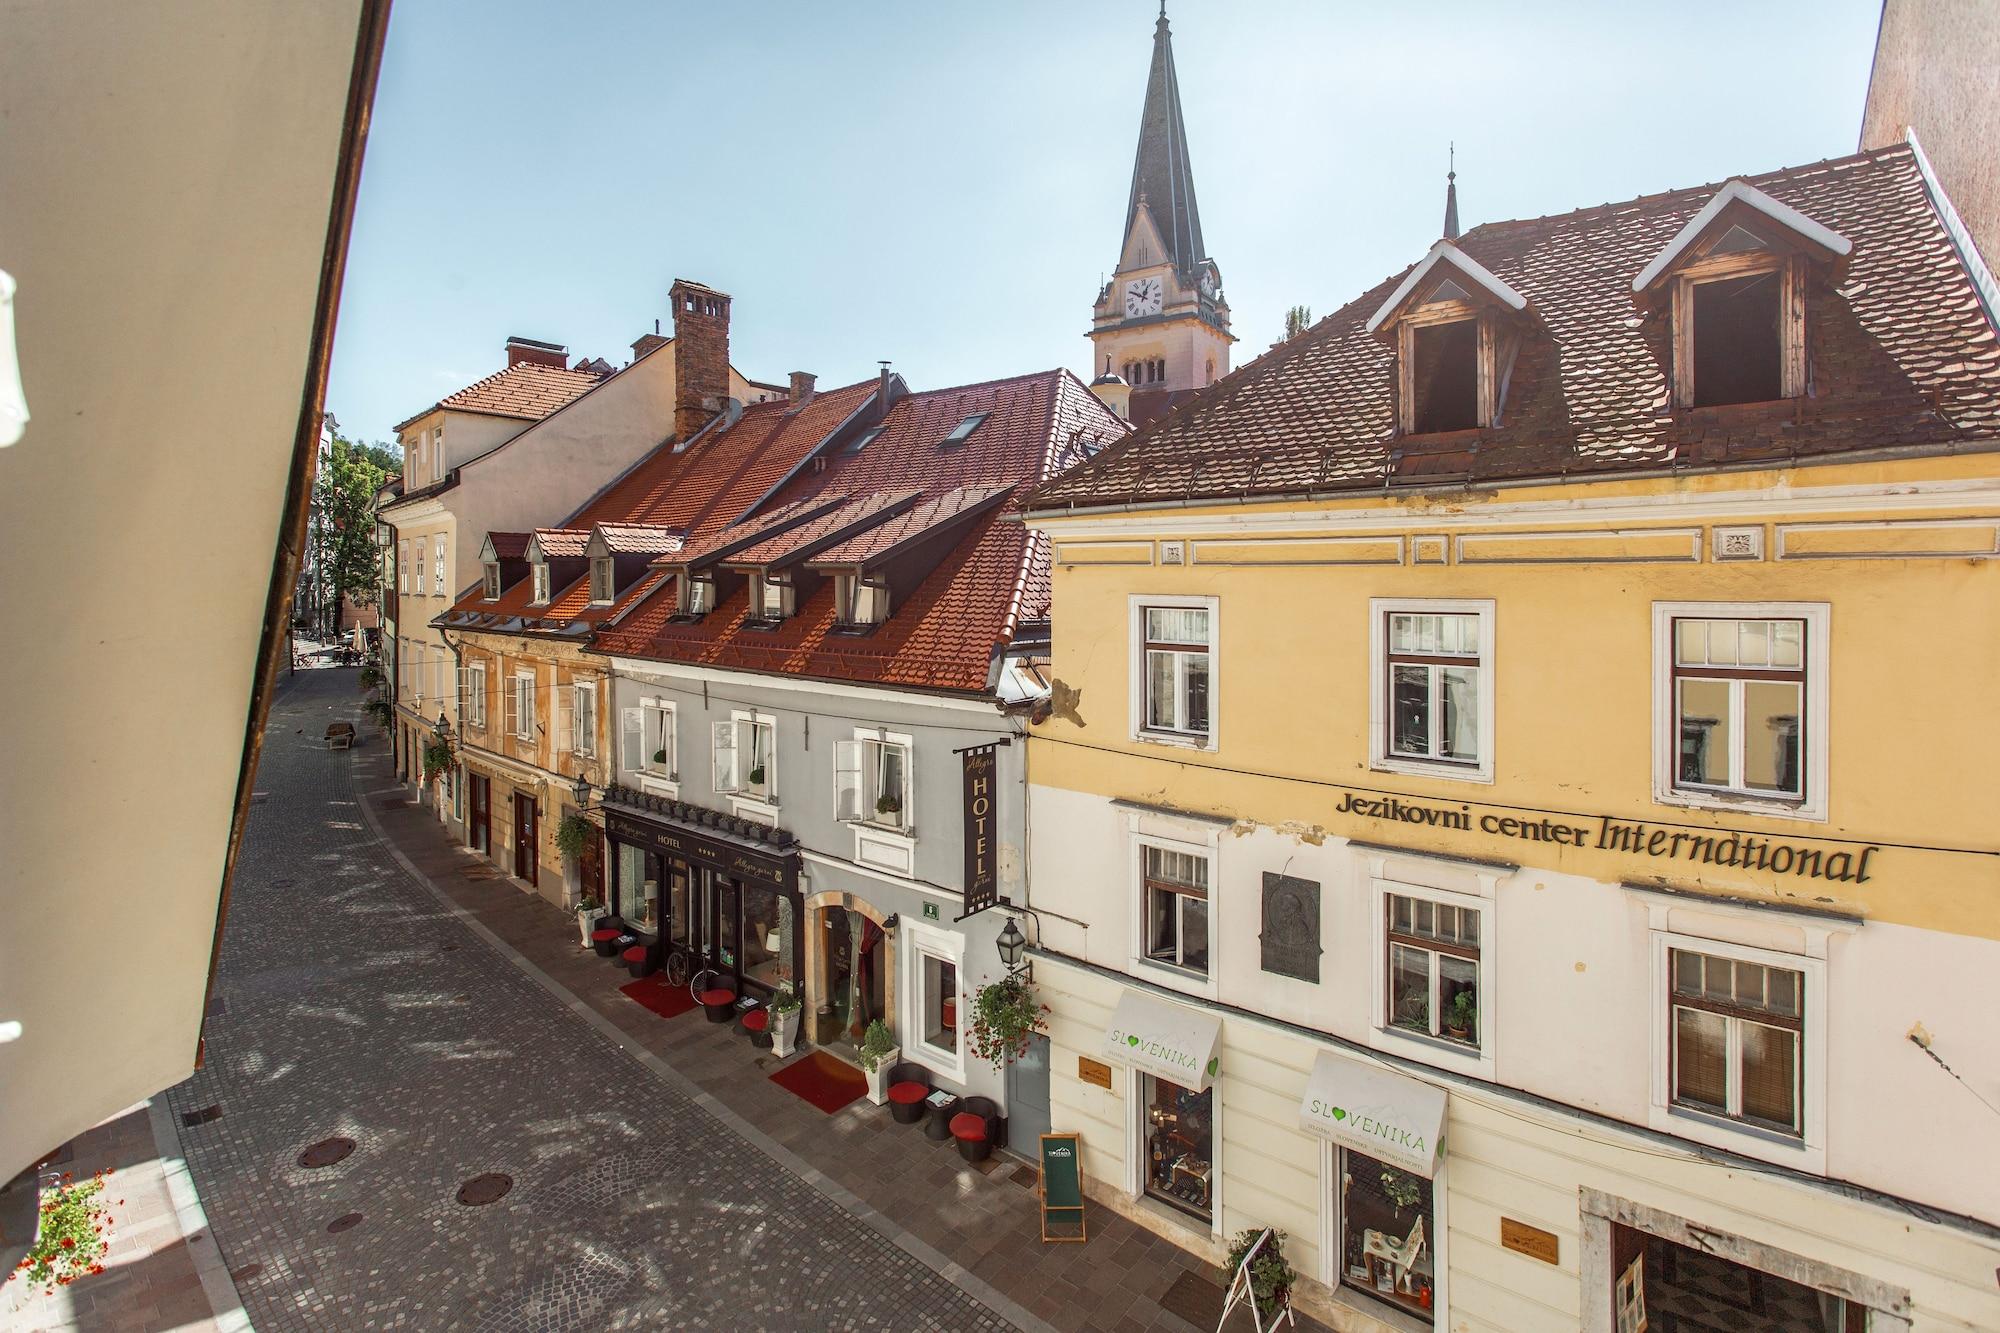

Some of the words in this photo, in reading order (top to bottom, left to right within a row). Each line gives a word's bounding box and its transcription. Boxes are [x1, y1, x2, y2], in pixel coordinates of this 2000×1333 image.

[657, 834, 682, 849] HOTEL
[972, 776, 989, 876] HOTEL
[1336, 792, 1470, 832] Jezikovni
[1480, 814, 1589, 848] center
[1594, 815, 1880, 885] International
[928, 906, 933, 914] 6
